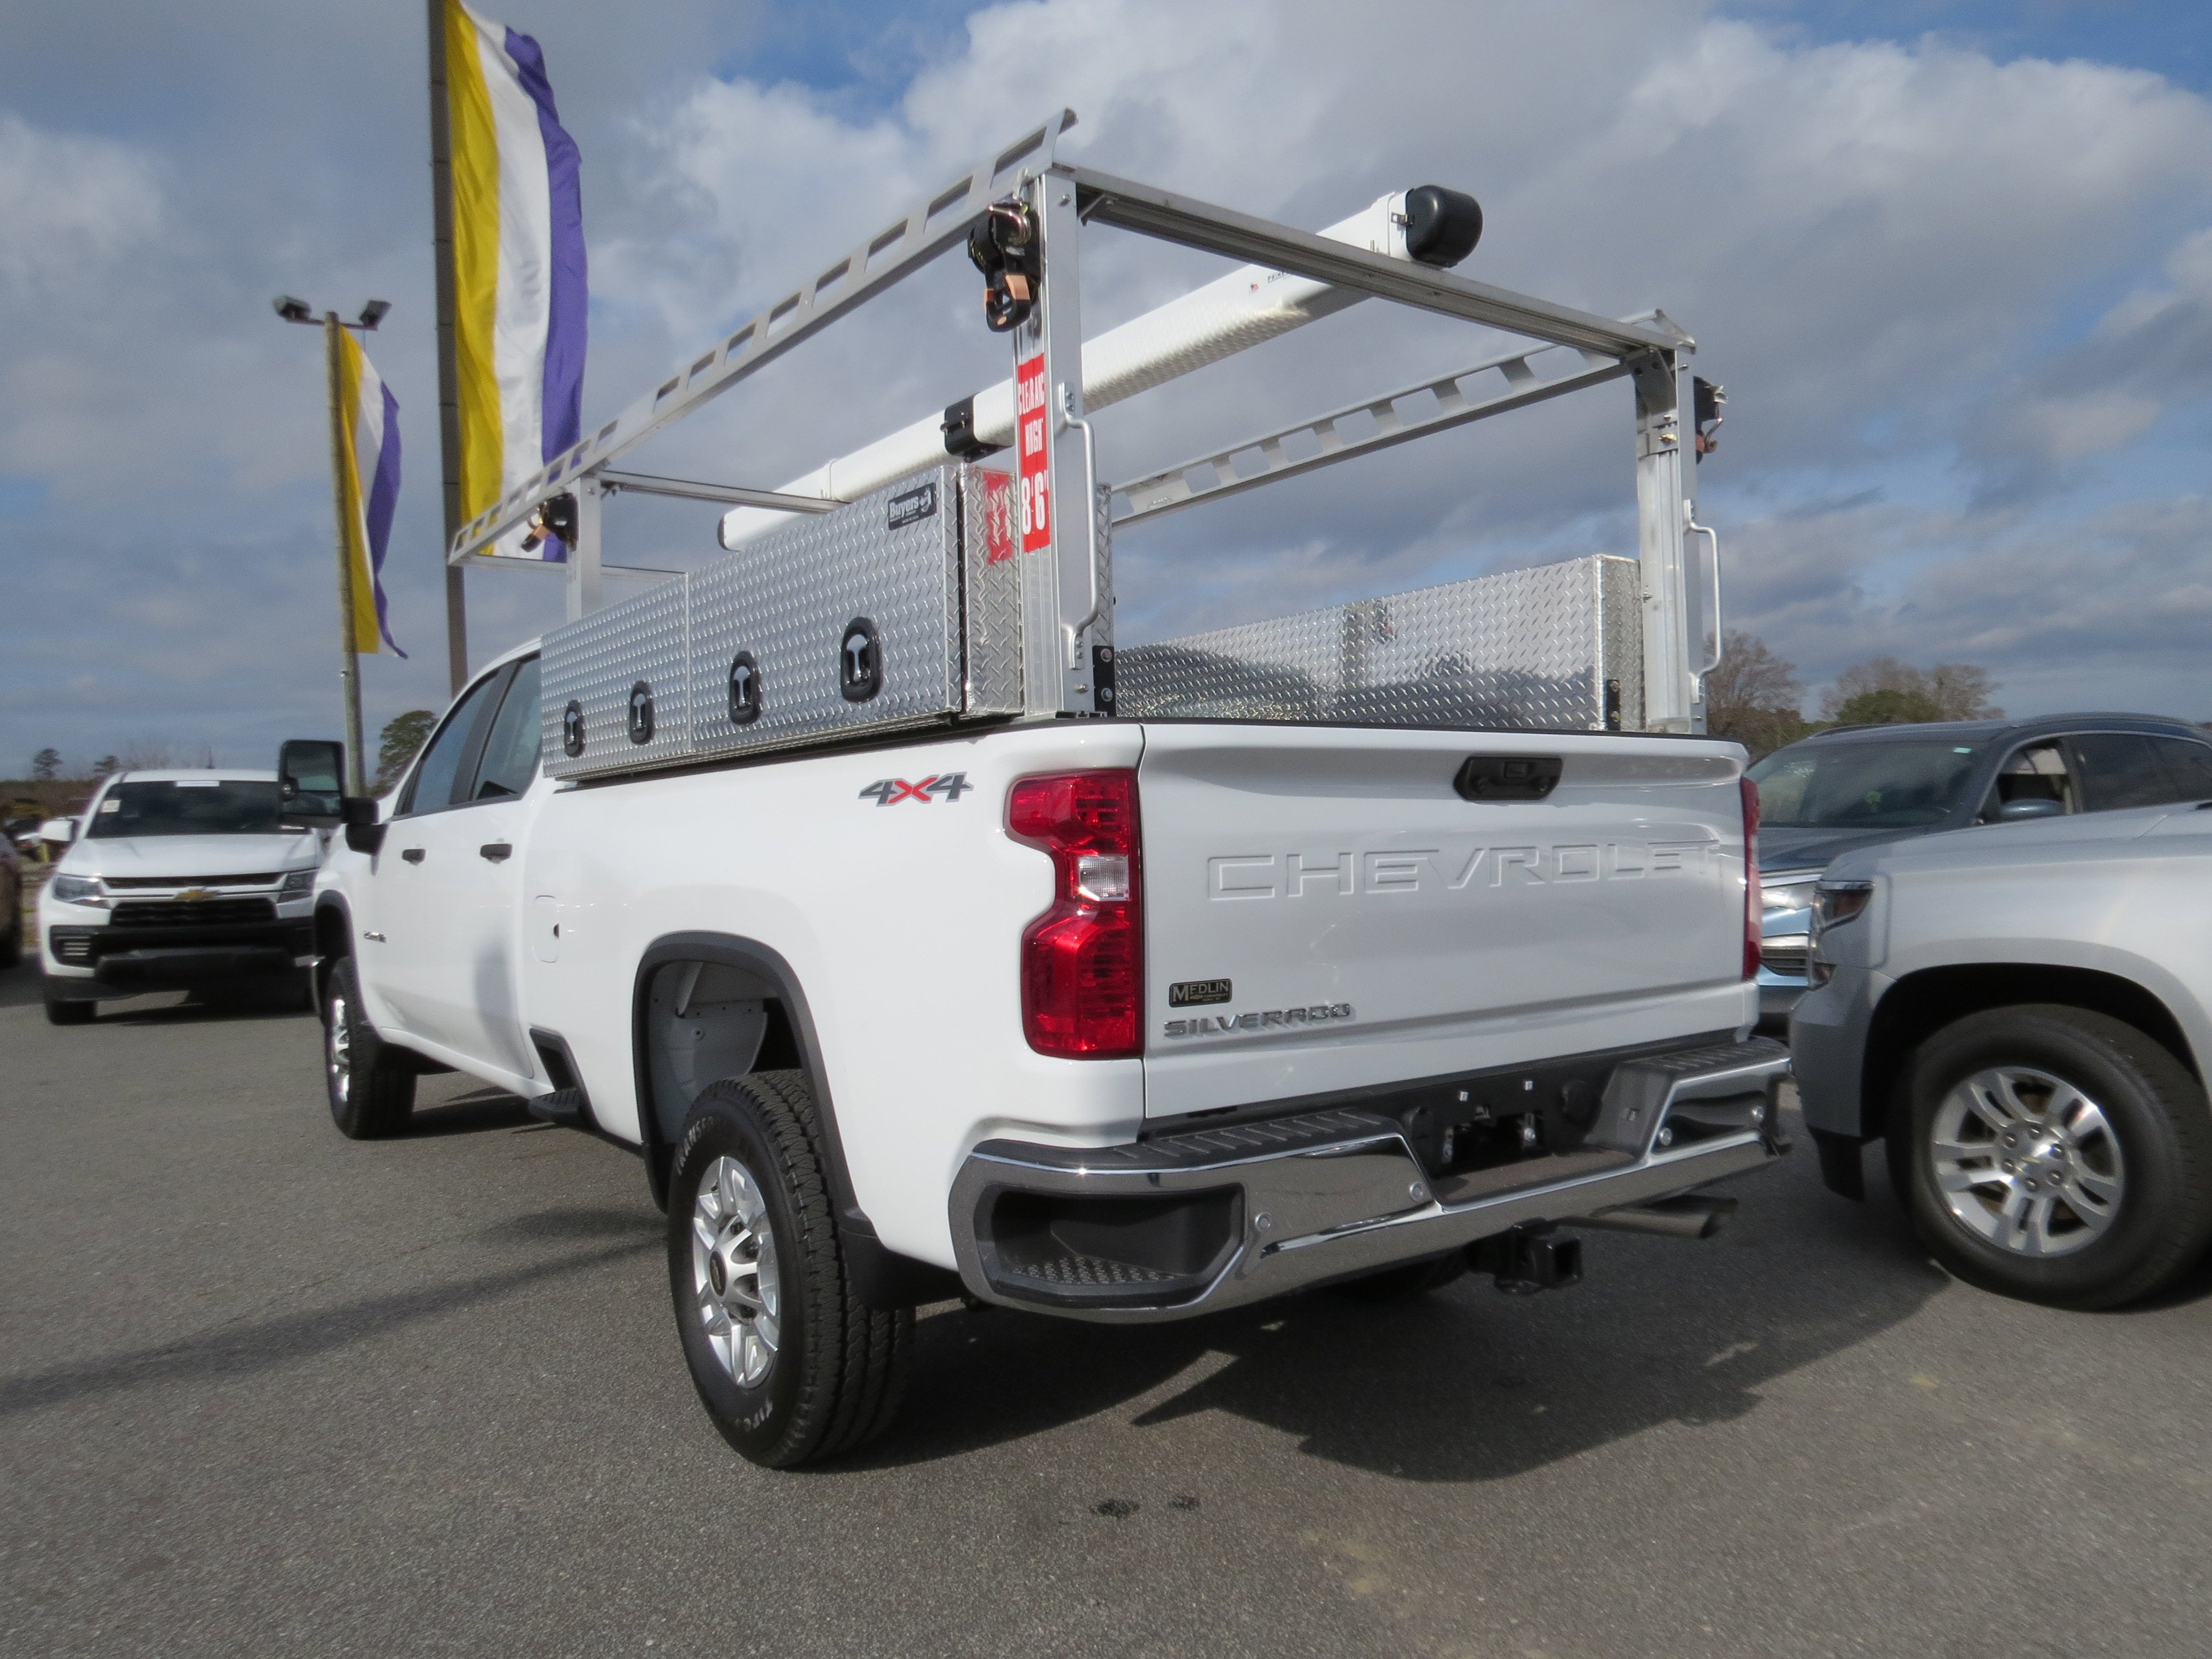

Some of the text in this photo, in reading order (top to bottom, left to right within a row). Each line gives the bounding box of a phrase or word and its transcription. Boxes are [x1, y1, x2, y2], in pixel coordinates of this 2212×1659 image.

[889, 496, 919, 519] Buyers
[1208, 839, 1720, 901] CHEVROLET
[1172, 982, 1229, 1002] MEDLIN
[1164, 1003, 1350, 1037] SILVERADO
